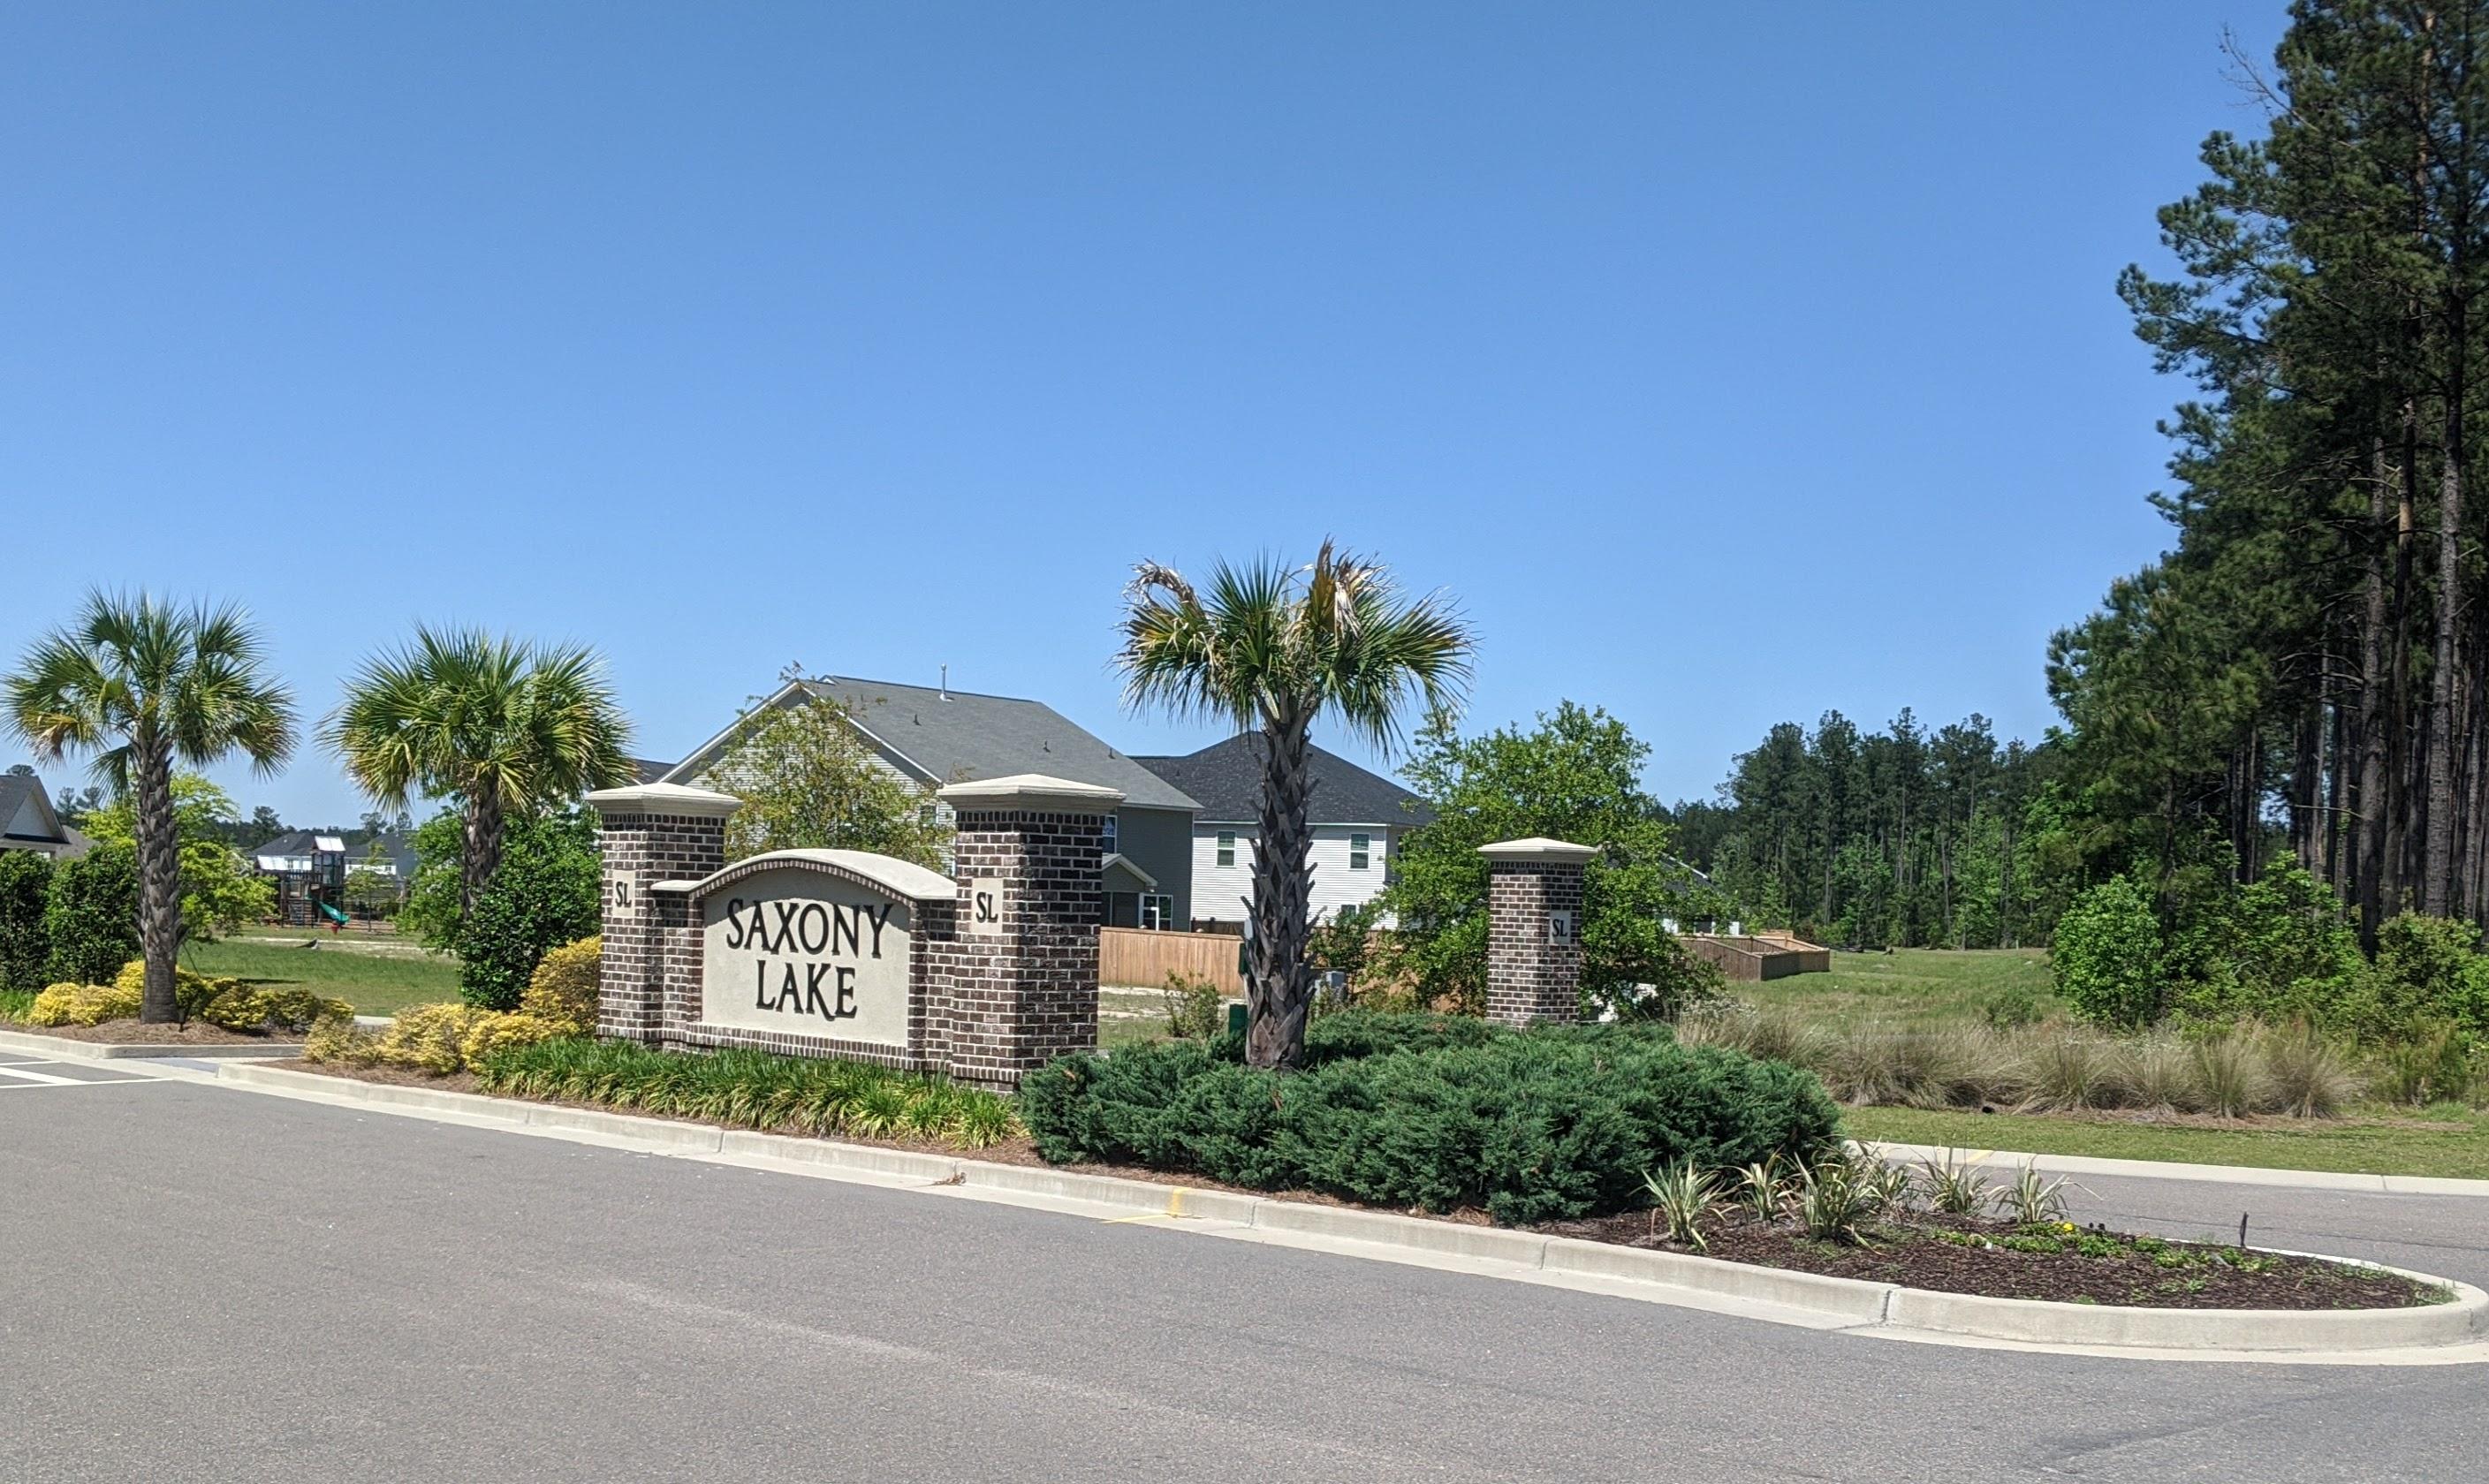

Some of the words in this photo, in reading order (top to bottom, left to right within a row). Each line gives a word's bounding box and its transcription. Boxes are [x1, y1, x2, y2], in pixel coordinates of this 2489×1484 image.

[615, 881, 633, 908] SL
[975, 890, 999, 924] SL
[726, 897, 893, 959] SAXONY
[1552, 918, 1568, 937] SL
[755, 959, 859, 1022] LAKE
